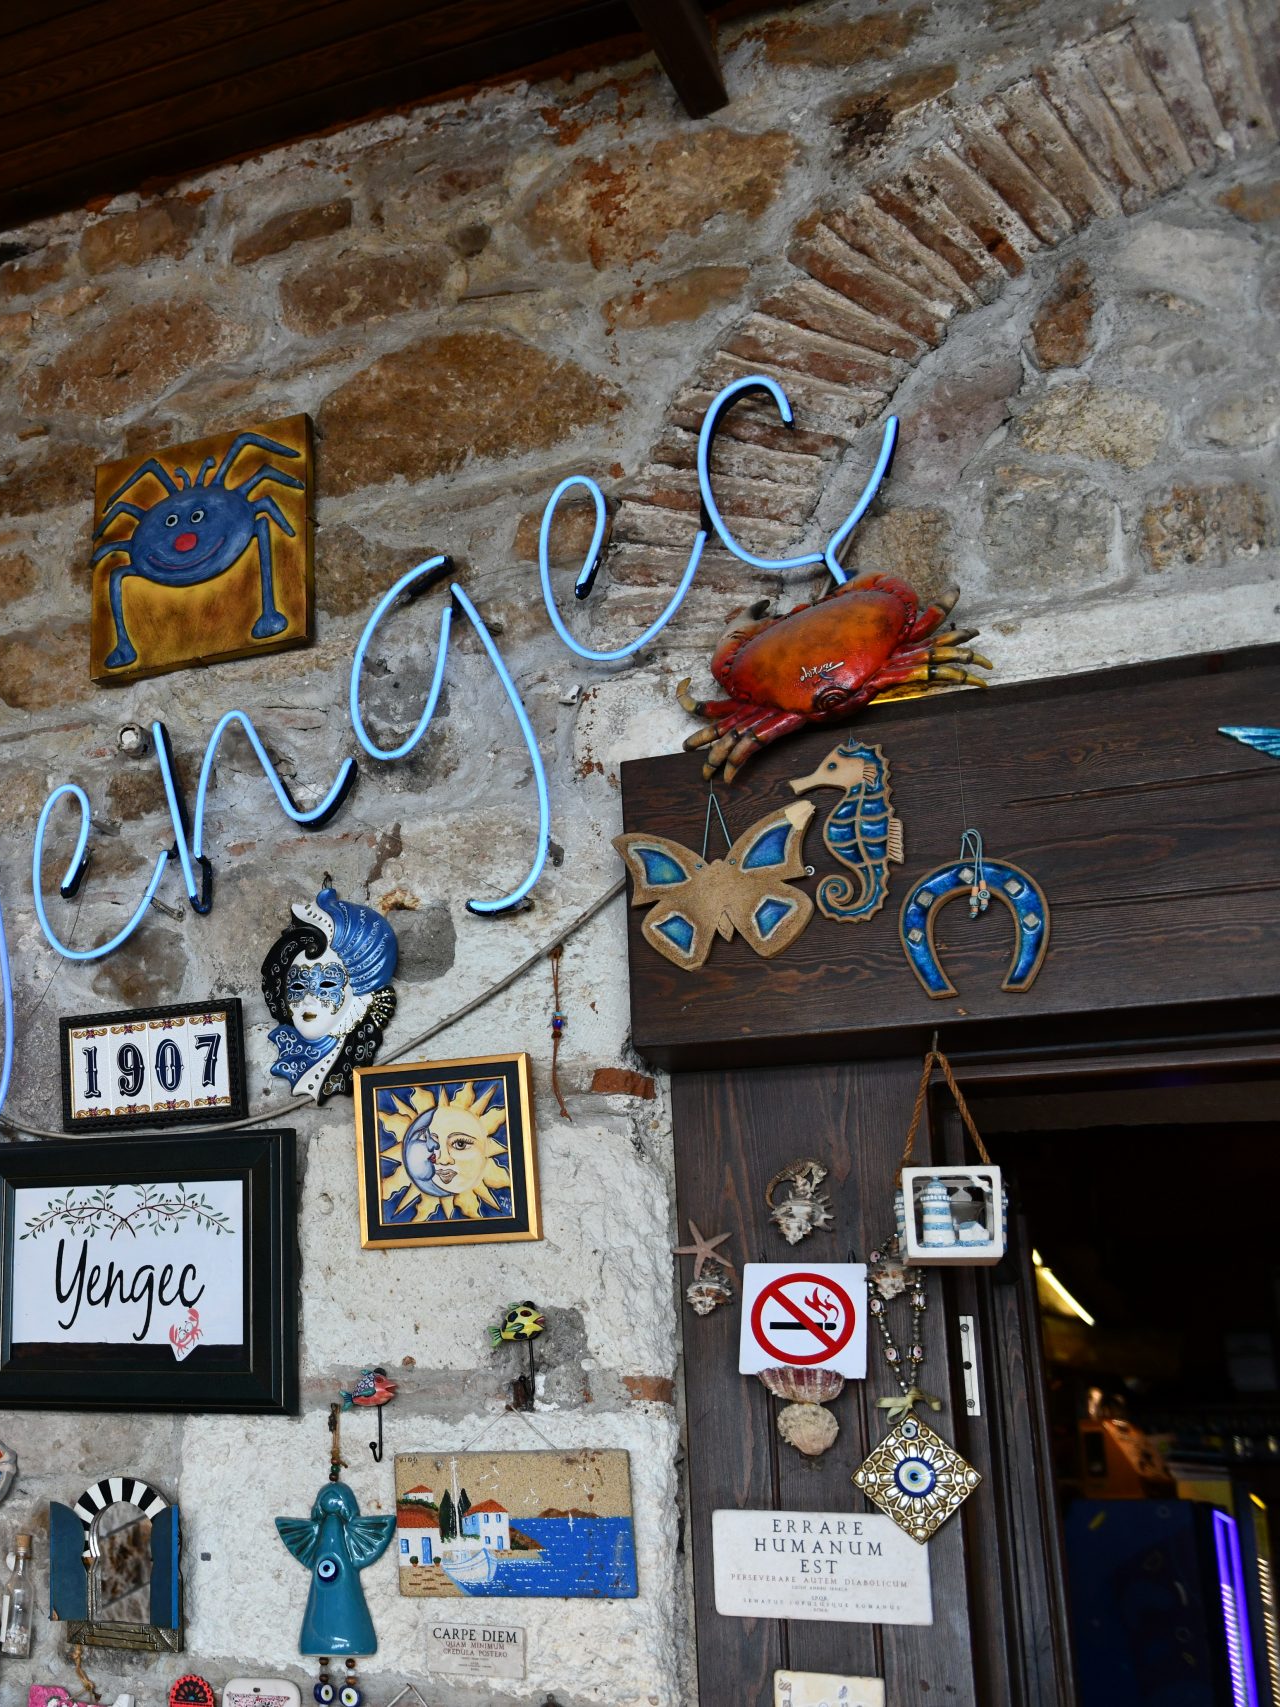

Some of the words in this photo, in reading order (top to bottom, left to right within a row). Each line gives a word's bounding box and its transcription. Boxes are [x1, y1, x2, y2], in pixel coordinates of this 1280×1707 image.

[81, 1032, 222, 1099] 1907
[772, 1518, 864, 1536] ERRARE
[754, 1537, 884, 1557] HUMANUM
[800, 1559, 838, 1575] EST
[731, 1573, 797, 1583] PERSEVERARE
[803, 1577, 838, 1586] AUTEM
[844, 1578, 908, 1589] DIABOLICUM
[433, 1627, 476, 1641] CARPE
[482, 1629, 518, 1644] DIEM
[443, 1648, 475, 1656] CREDULA
[479, 1650, 508, 1658] POSTERO
[445, 1640, 467, 1648] QUAM
[471, 1641, 505, 1650] MINIMUM
